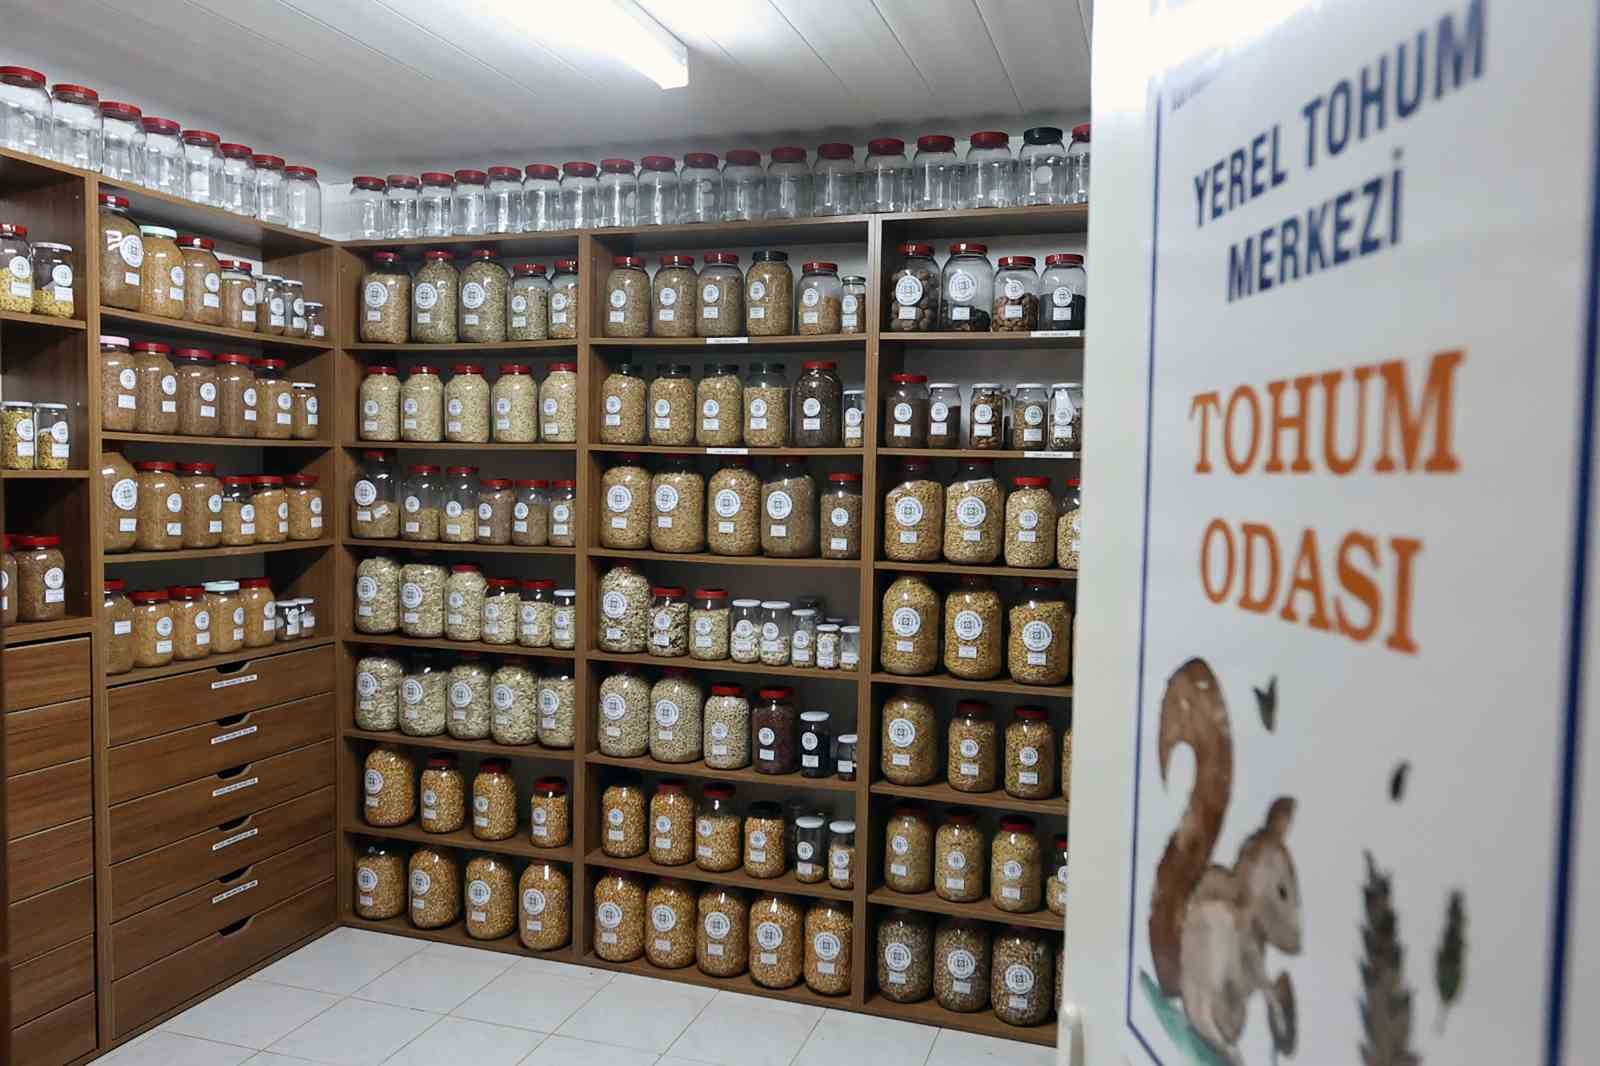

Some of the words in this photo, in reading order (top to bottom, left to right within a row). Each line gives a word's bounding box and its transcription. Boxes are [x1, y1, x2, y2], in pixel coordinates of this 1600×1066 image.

[1194, 123, 1287, 229] YEREL
[1301, 0, 1486, 168] TOHUM
[1227, 147, 1404, 304] MERKEZİ
[1189, 346, 1467, 475] TOHUM
[1201, 517, 1424, 656] ODASI
